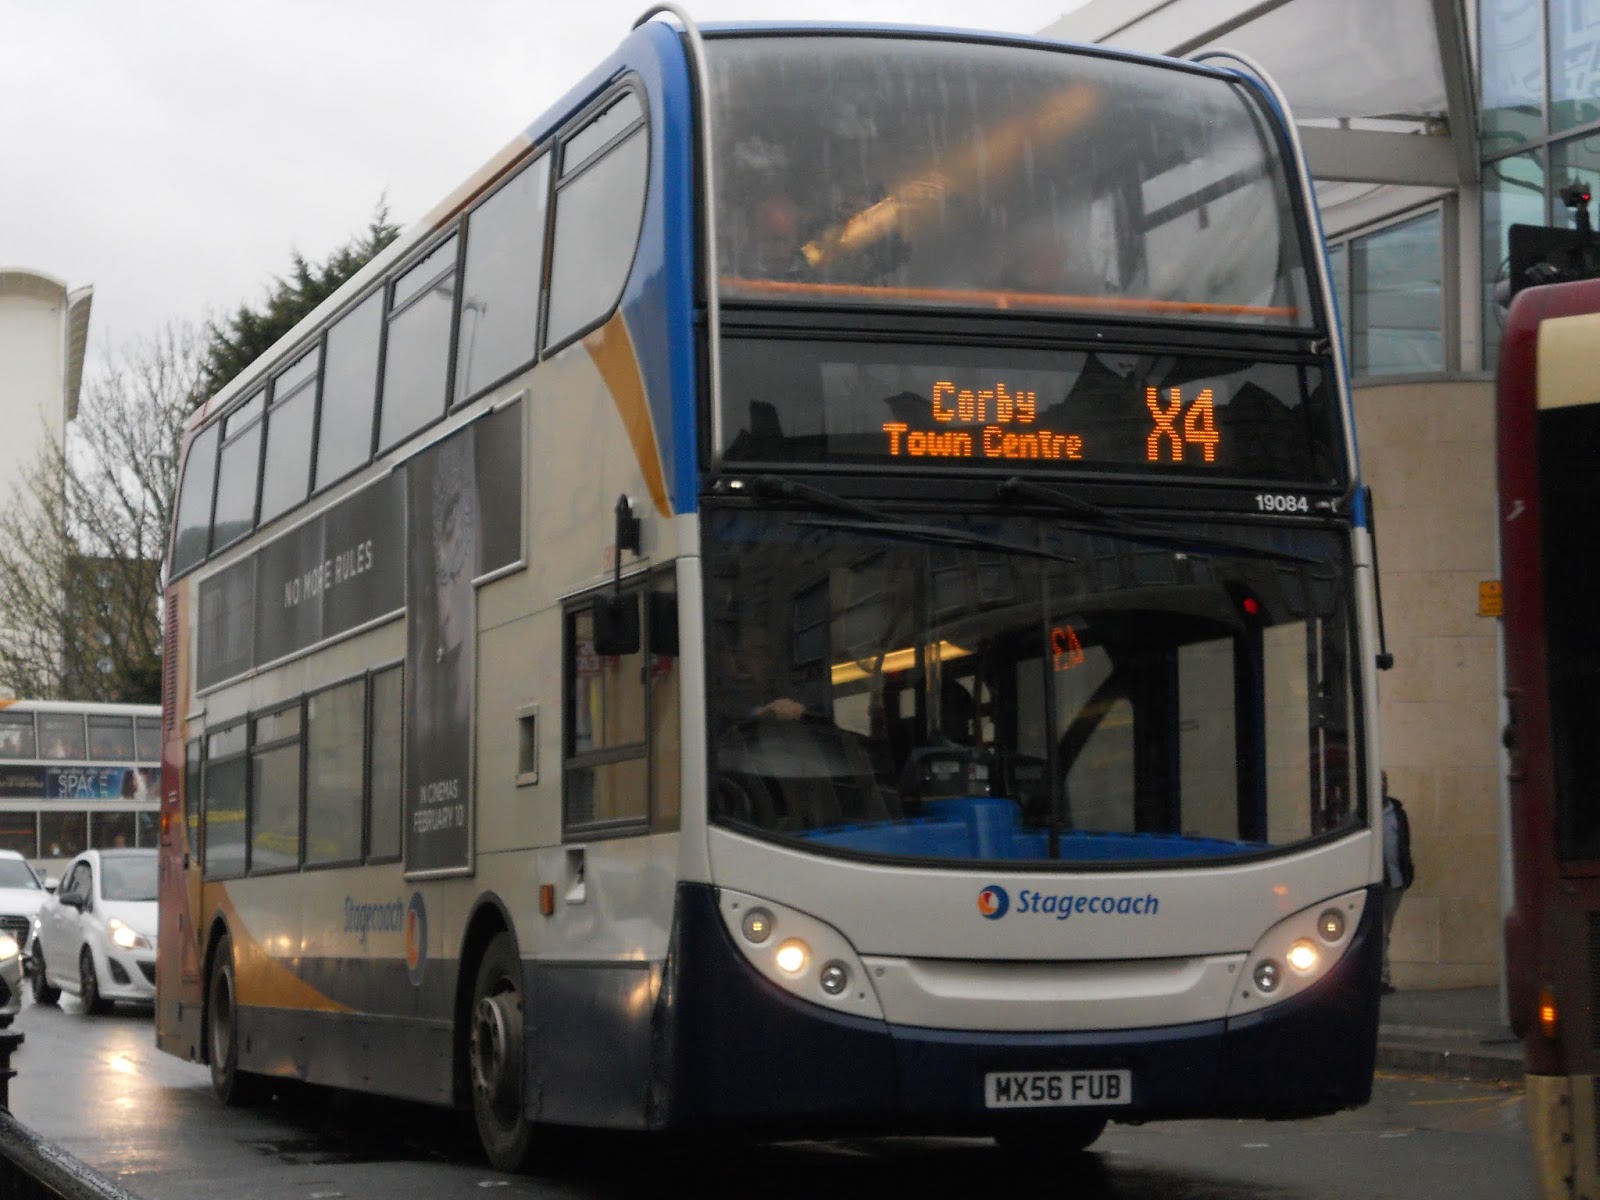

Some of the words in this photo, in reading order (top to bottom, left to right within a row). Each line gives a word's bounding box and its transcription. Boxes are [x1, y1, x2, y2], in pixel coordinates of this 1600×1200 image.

[932, 380, 1035, 423] Corby
[883, 422, 972, 456] Town
[983, 425, 1083, 459] Centre
[1146, 386, 1219, 462] X4
[1255, 494, 1309, 512] 19084
[284, 577, 300, 608] NO
[303, 560, 331, 600] MORE
[335, 539, 373, 584] RULES
[58, 773, 108, 794] SPACE
[420, 784, 428, 804] IN
[344, 895, 403, 944] Stagecoach
[1017, 890, 1159, 921] Stagecoach
[994, 1076, 1063, 1103] MX56
[1071, 1074, 1121, 1100] FUB
